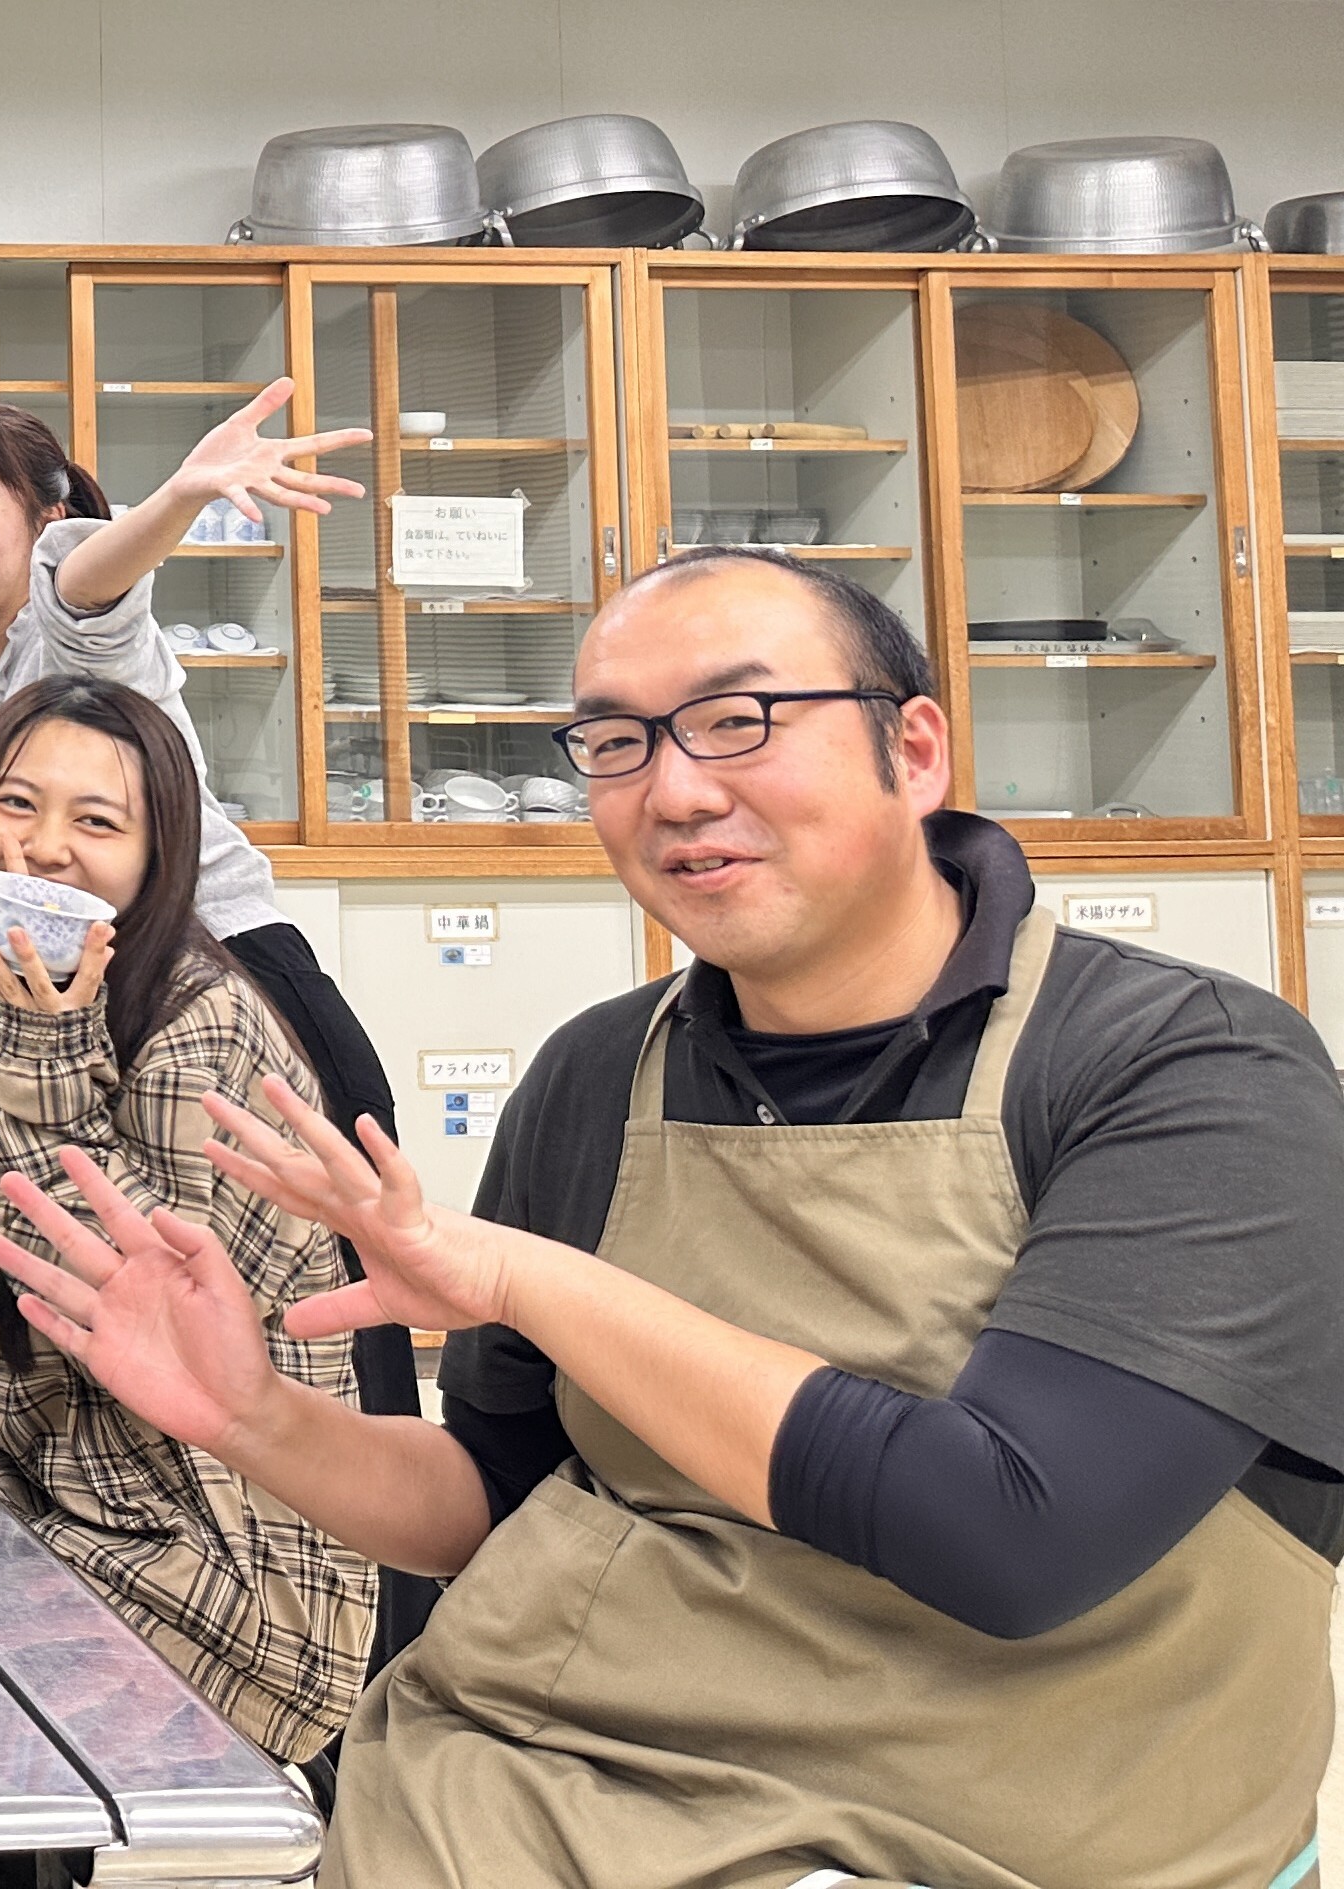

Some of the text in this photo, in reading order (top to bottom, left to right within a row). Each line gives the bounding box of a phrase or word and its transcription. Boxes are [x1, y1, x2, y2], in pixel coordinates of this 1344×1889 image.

[435, 506, 476, 519] お願い
[1076, 905, 1145, 920] 米揚げザル
[438, 915, 489, 930] 中華鍋
[432, 1062, 502, 1076] フライパン
